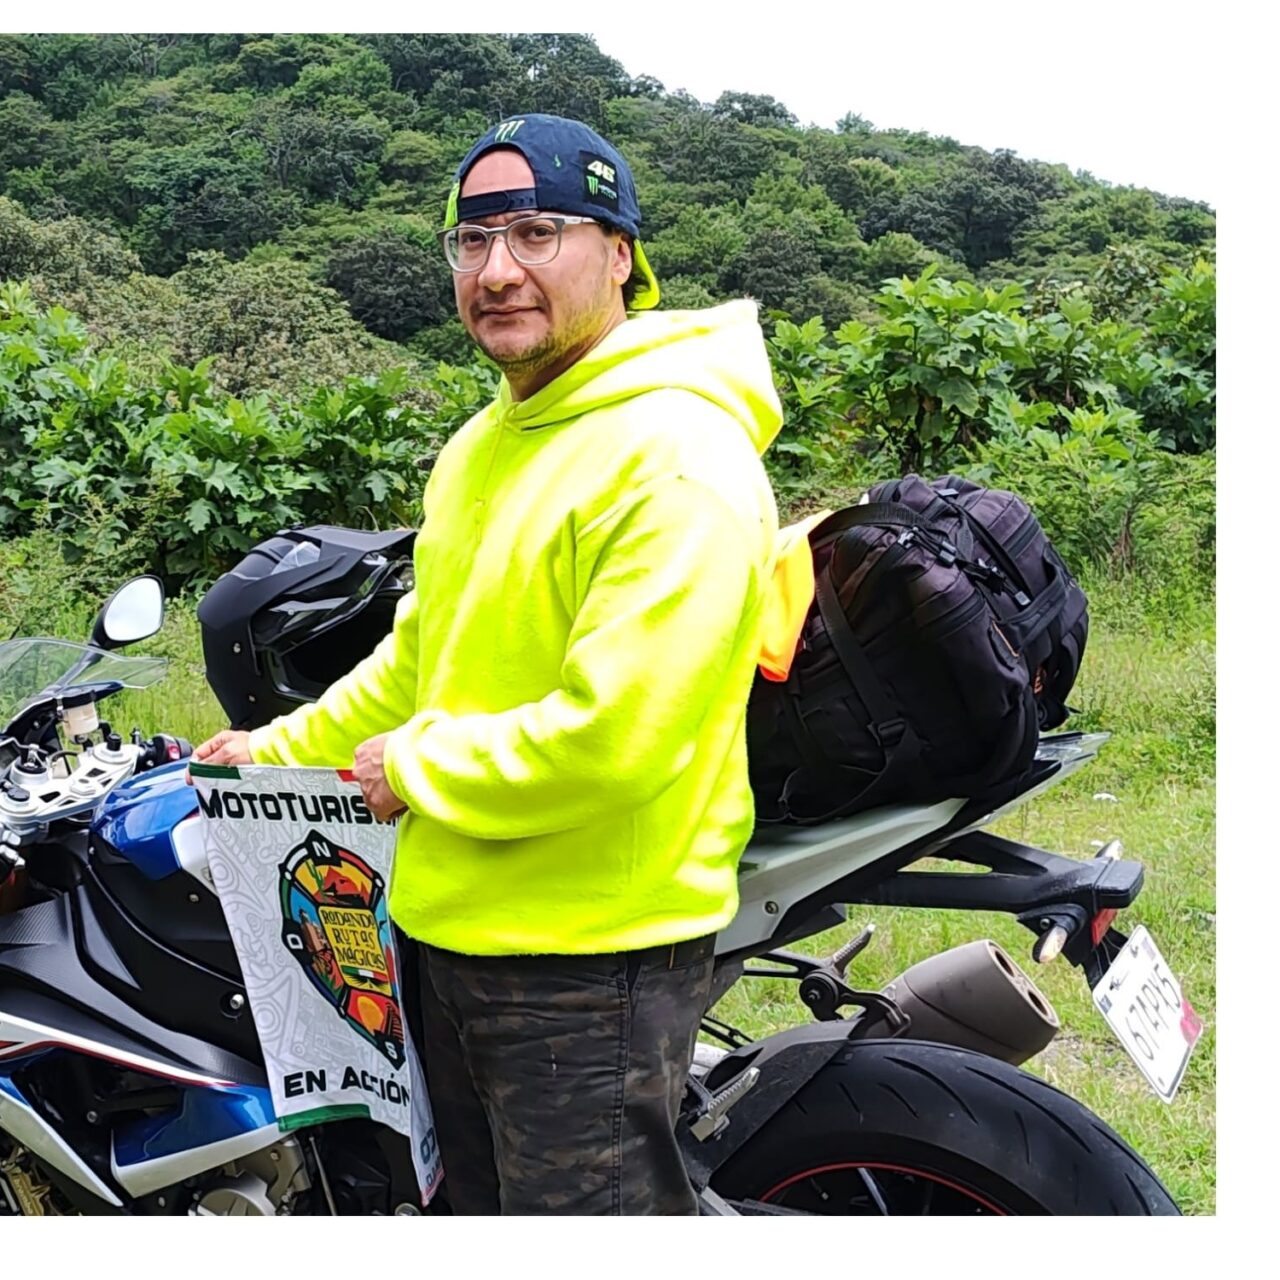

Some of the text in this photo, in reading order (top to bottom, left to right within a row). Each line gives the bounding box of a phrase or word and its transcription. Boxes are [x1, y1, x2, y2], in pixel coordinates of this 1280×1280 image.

[587, 160, 615, 183] 46
[312, 841, 331, 858] N
[385, 1041, 398, 1060] S
[284, 1069, 326, 1099] EN
